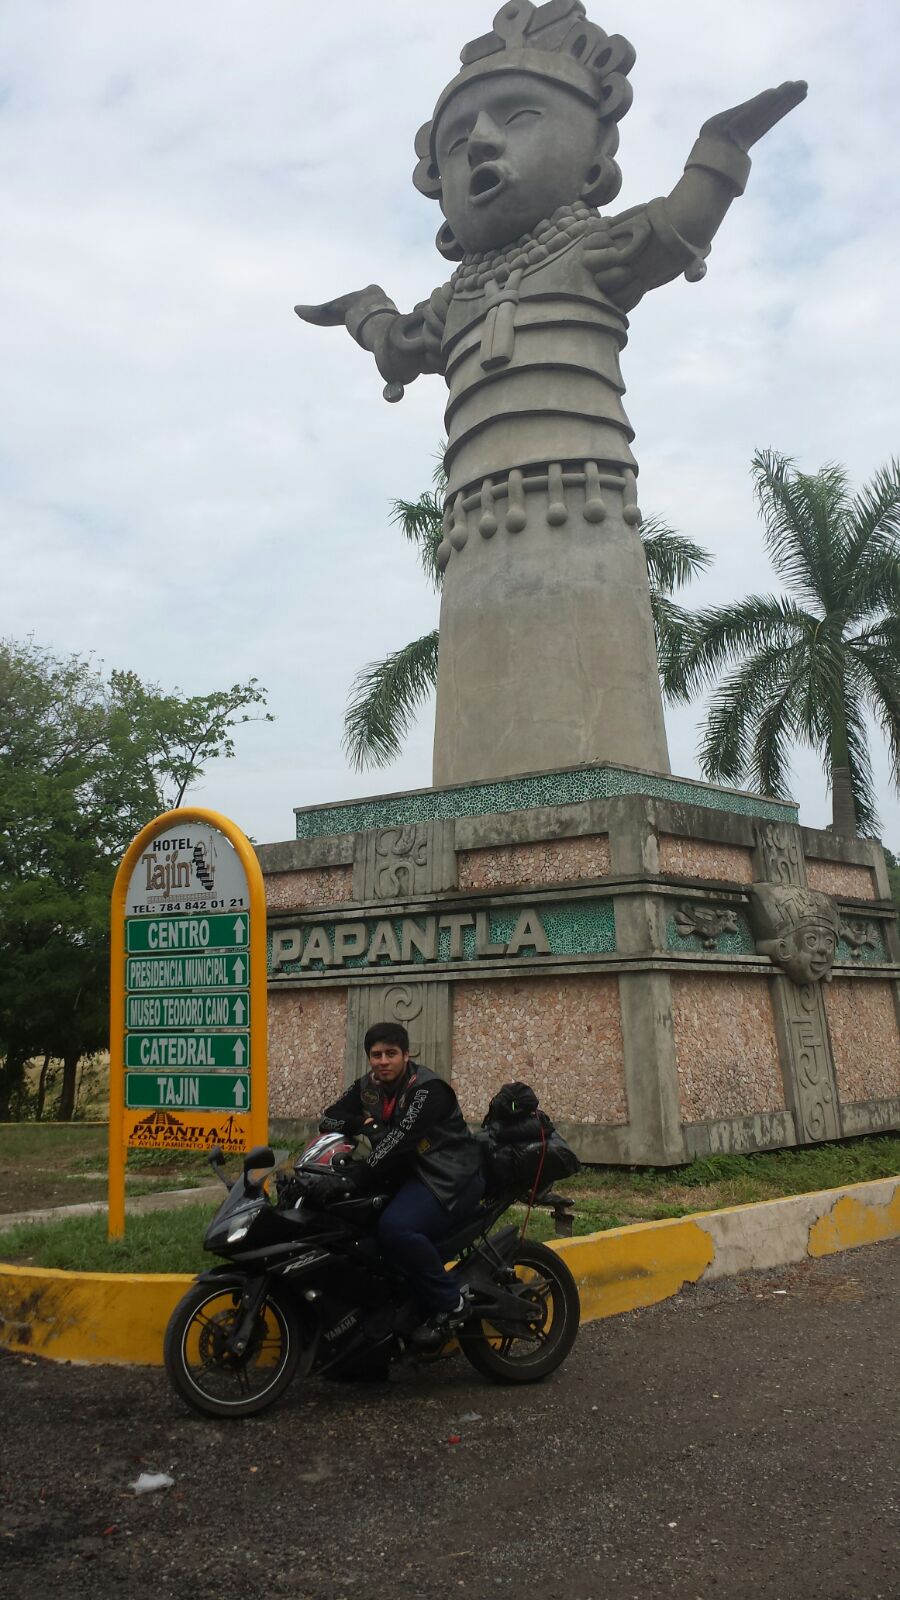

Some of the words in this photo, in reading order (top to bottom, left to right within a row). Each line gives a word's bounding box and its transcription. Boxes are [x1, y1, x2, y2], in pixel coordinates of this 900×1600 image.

[153, 838, 193, 851] HOTEL
[132, 905, 155, 913] TEL:
[160, 903, 180, 911] 784
[185, 901, 206, 910] 842
[211, 899, 224, 908] 01
[230, 898, 244, 907] 21
[148, 919, 210, 949] CENTRO
[271, 908, 550, 969] PAPANTLA
[130, 959, 183, 988] PRESIDENCIA
[185, 957, 229, 986] MUNICIPAL
[130, 999, 161, 1026] MUSEO
[163, 998, 203, 1026] TEODORO
[205, 997, 229, 1024] CANO
[140, 1038, 216, 1065] CATEDRAL
[157, 1077, 200, 1105] TAJIN
[133, 1125, 219, 1137] PAPANTLA
[138, 1141, 204, 1149] AYUNTAMIENTO
[323, 1316, 358, 1341] YAMAHA
